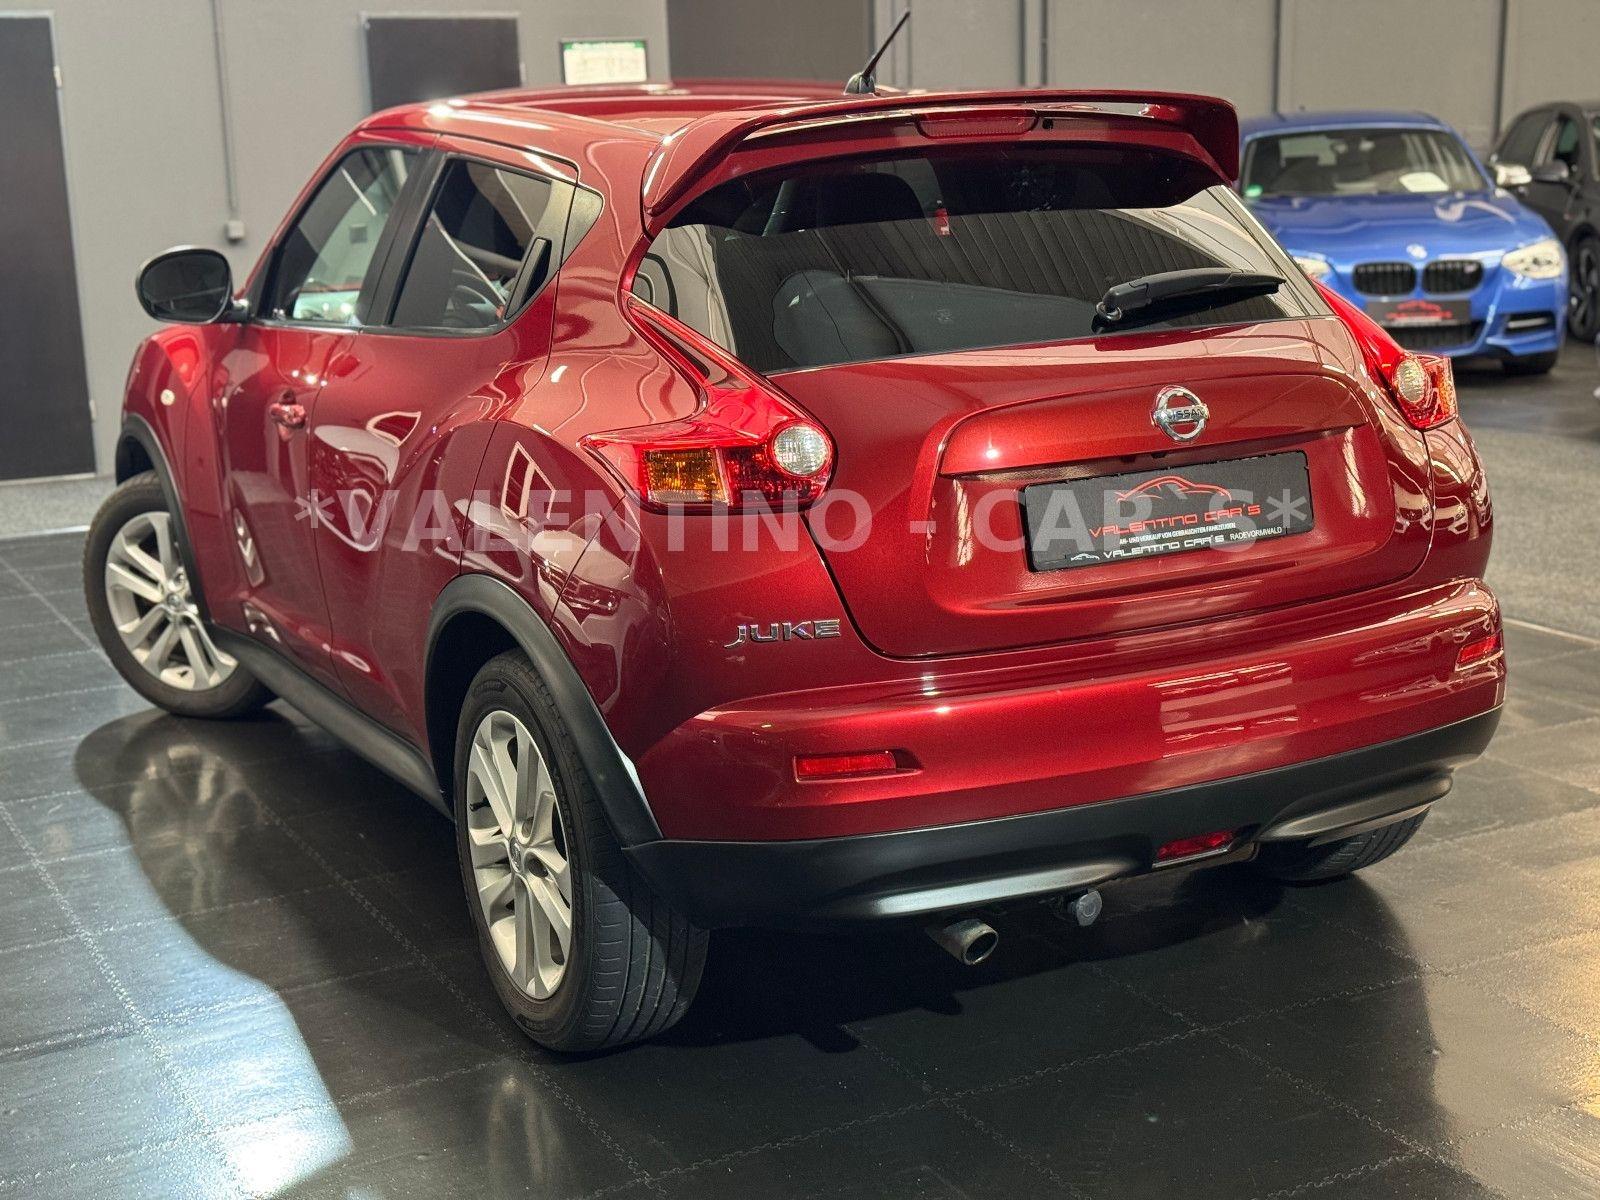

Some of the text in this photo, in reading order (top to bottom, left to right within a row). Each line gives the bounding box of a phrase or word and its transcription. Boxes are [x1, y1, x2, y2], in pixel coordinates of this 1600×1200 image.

[1089, 513, 1198, 538] VALENTINO
[1103, 541, 1180, 559] VALENTINO
[1230, 526, 1283, 541] RADEVORMWALD
[723, 619, 840, 649] JUKE
